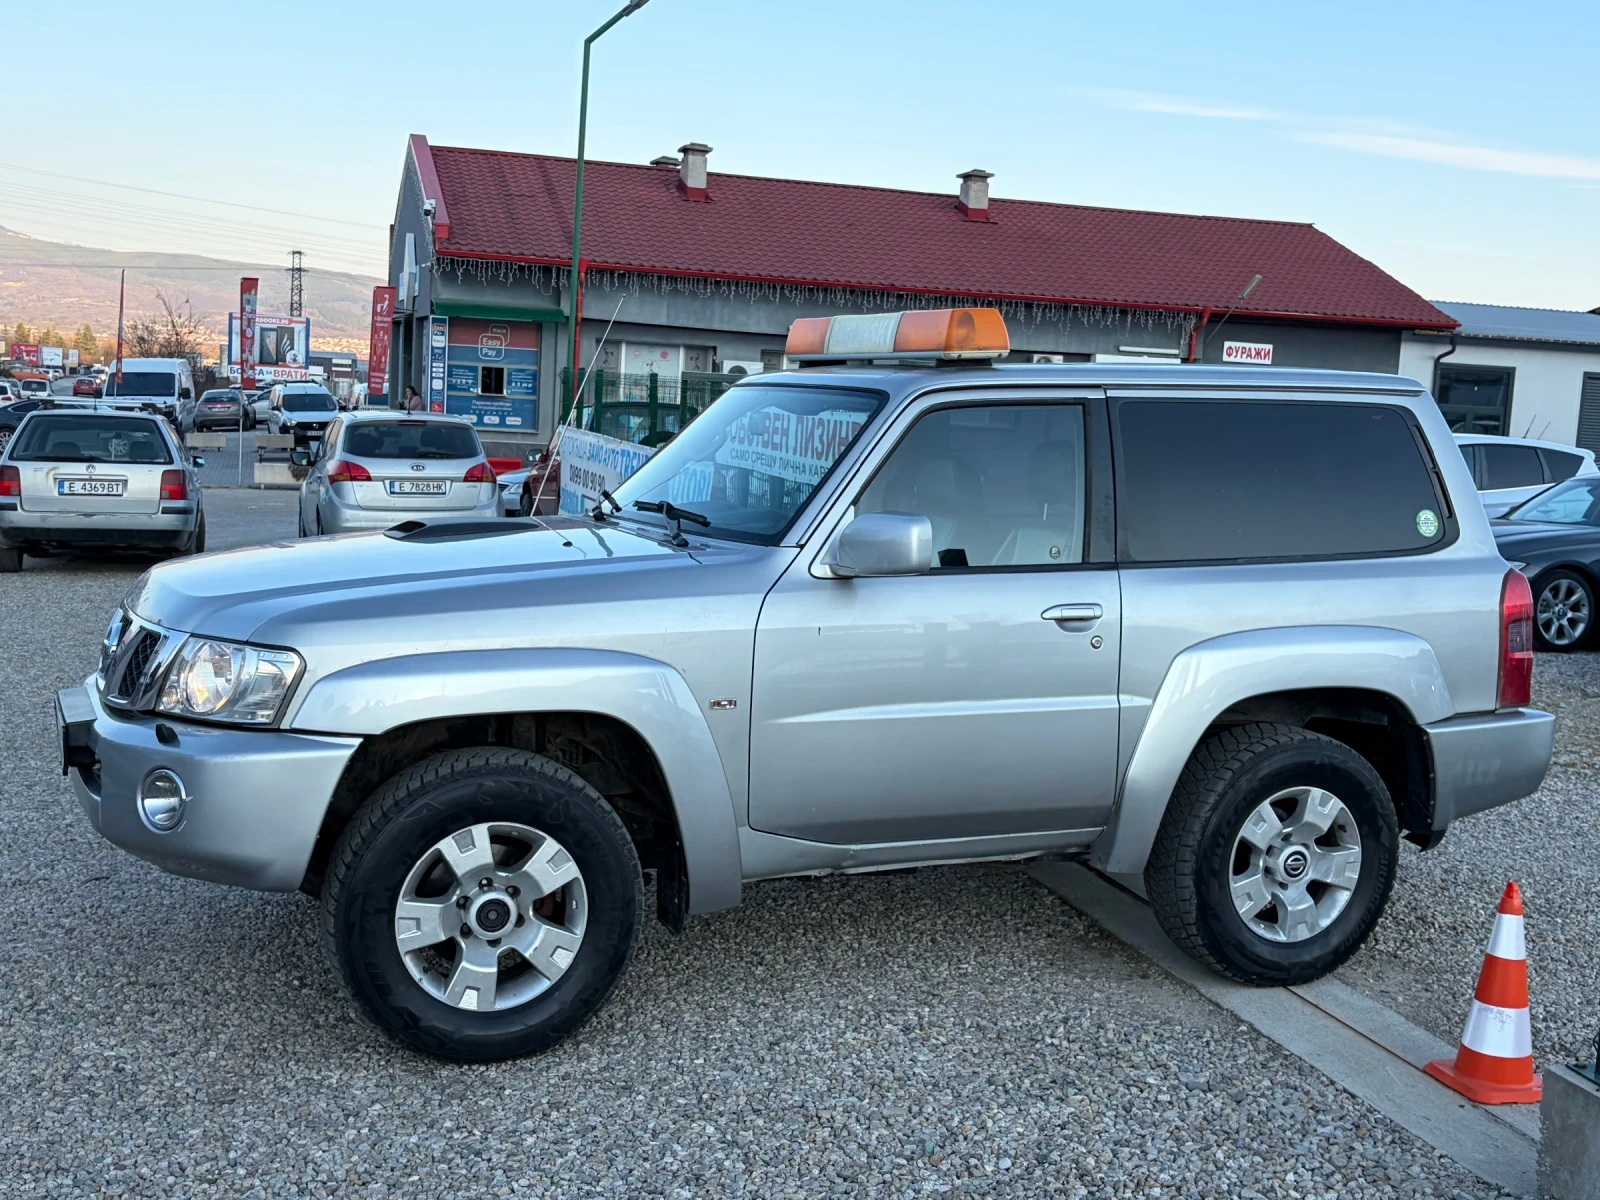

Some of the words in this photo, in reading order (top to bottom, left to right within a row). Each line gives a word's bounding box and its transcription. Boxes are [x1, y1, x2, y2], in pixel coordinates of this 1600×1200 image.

[256, 317, 289, 325] RDOORS.BG
[482, 337, 501, 348] Easy
[482, 348, 497, 357] Pay
[1225, 345, 1271, 361] ФУРАЖИ
[229, 366, 265, 377] БОА
[273, 369, 308, 380] ВРАТИ
[729, 411, 791, 455] ОБВЕН
[620, 448, 651, 483] TRE
[730, 448, 750, 463] САМО
[751, 450, 777, 469] СРЕЩУ
[778, 458, 806, 475] ЛИЧНА
[808, 464, 829, 479] КАР
[81, 482, 106, 493] 4369
[410, 482, 432, 492] 7828
